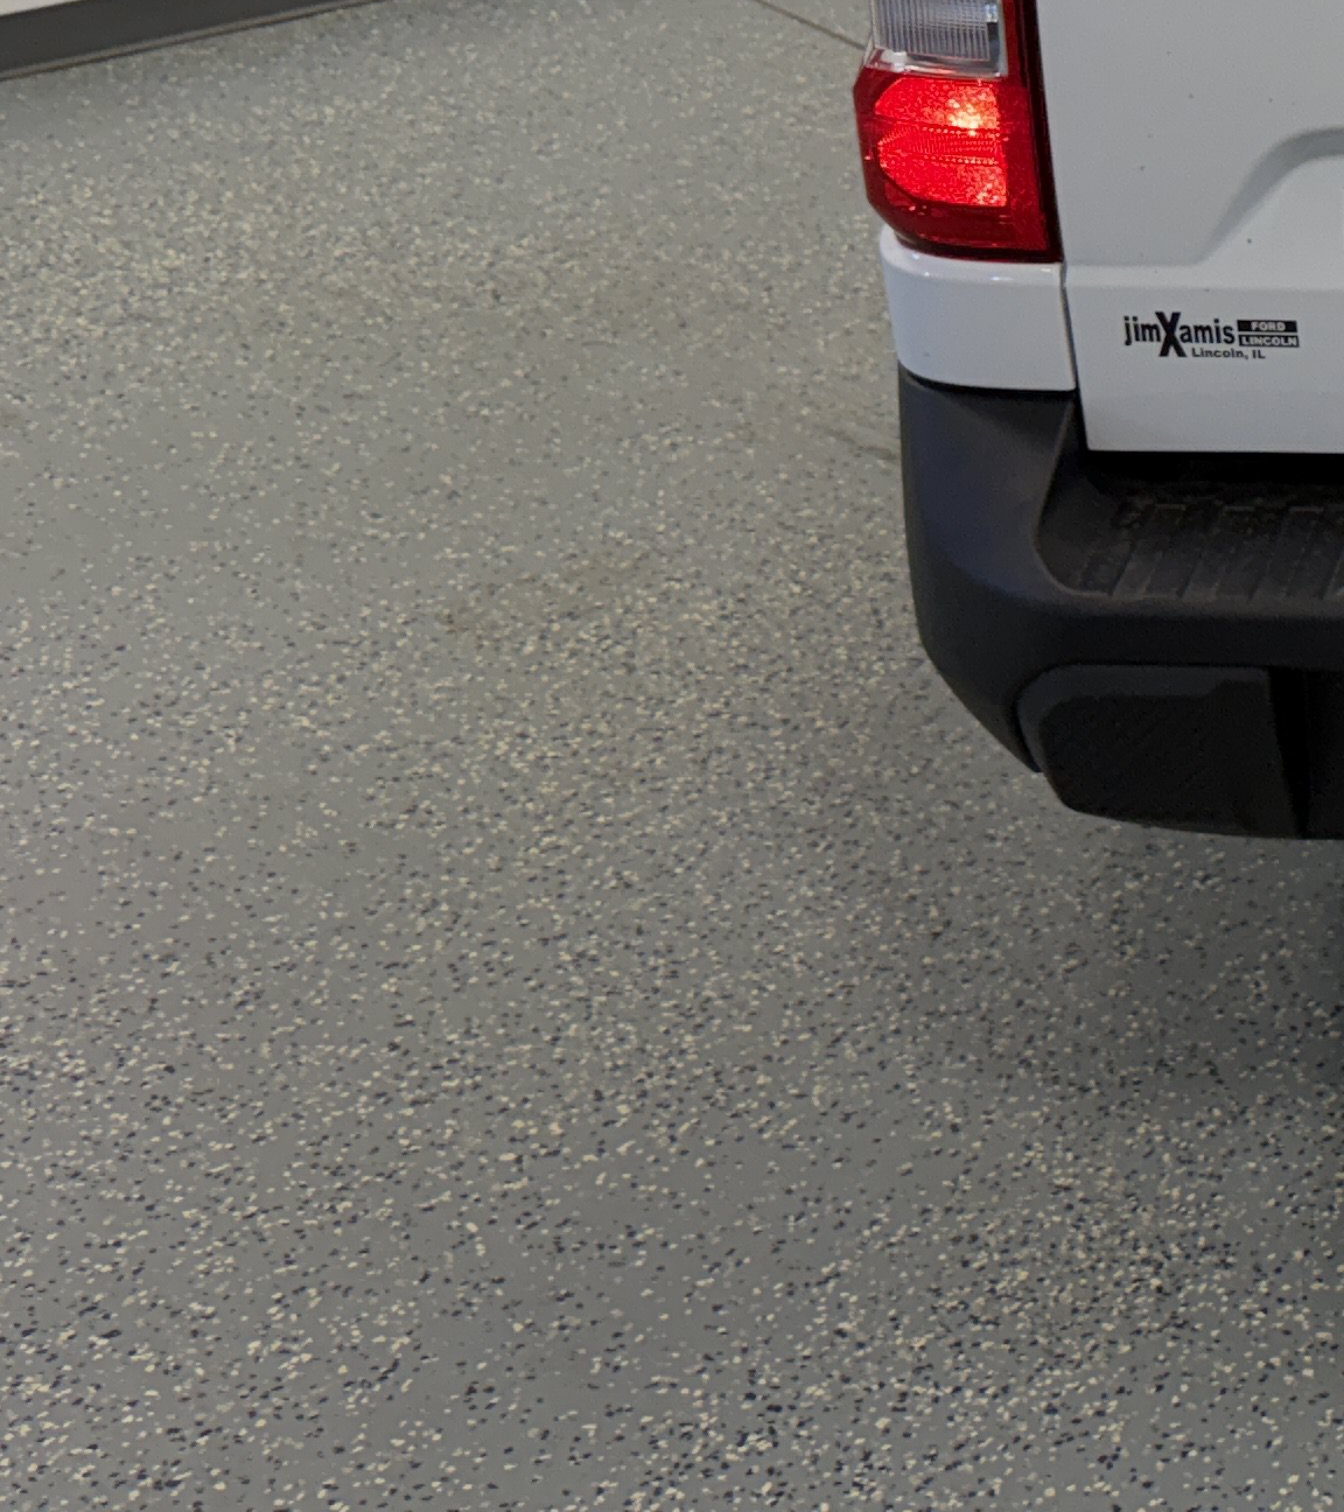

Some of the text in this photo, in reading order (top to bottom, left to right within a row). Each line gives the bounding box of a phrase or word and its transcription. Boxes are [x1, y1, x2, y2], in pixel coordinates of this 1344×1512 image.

[1250, 321, 1286, 332] FORD
[1241, 336, 1297, 346] LINCOLN
[1191, 347, 1266, 359] Lincoln, IL
